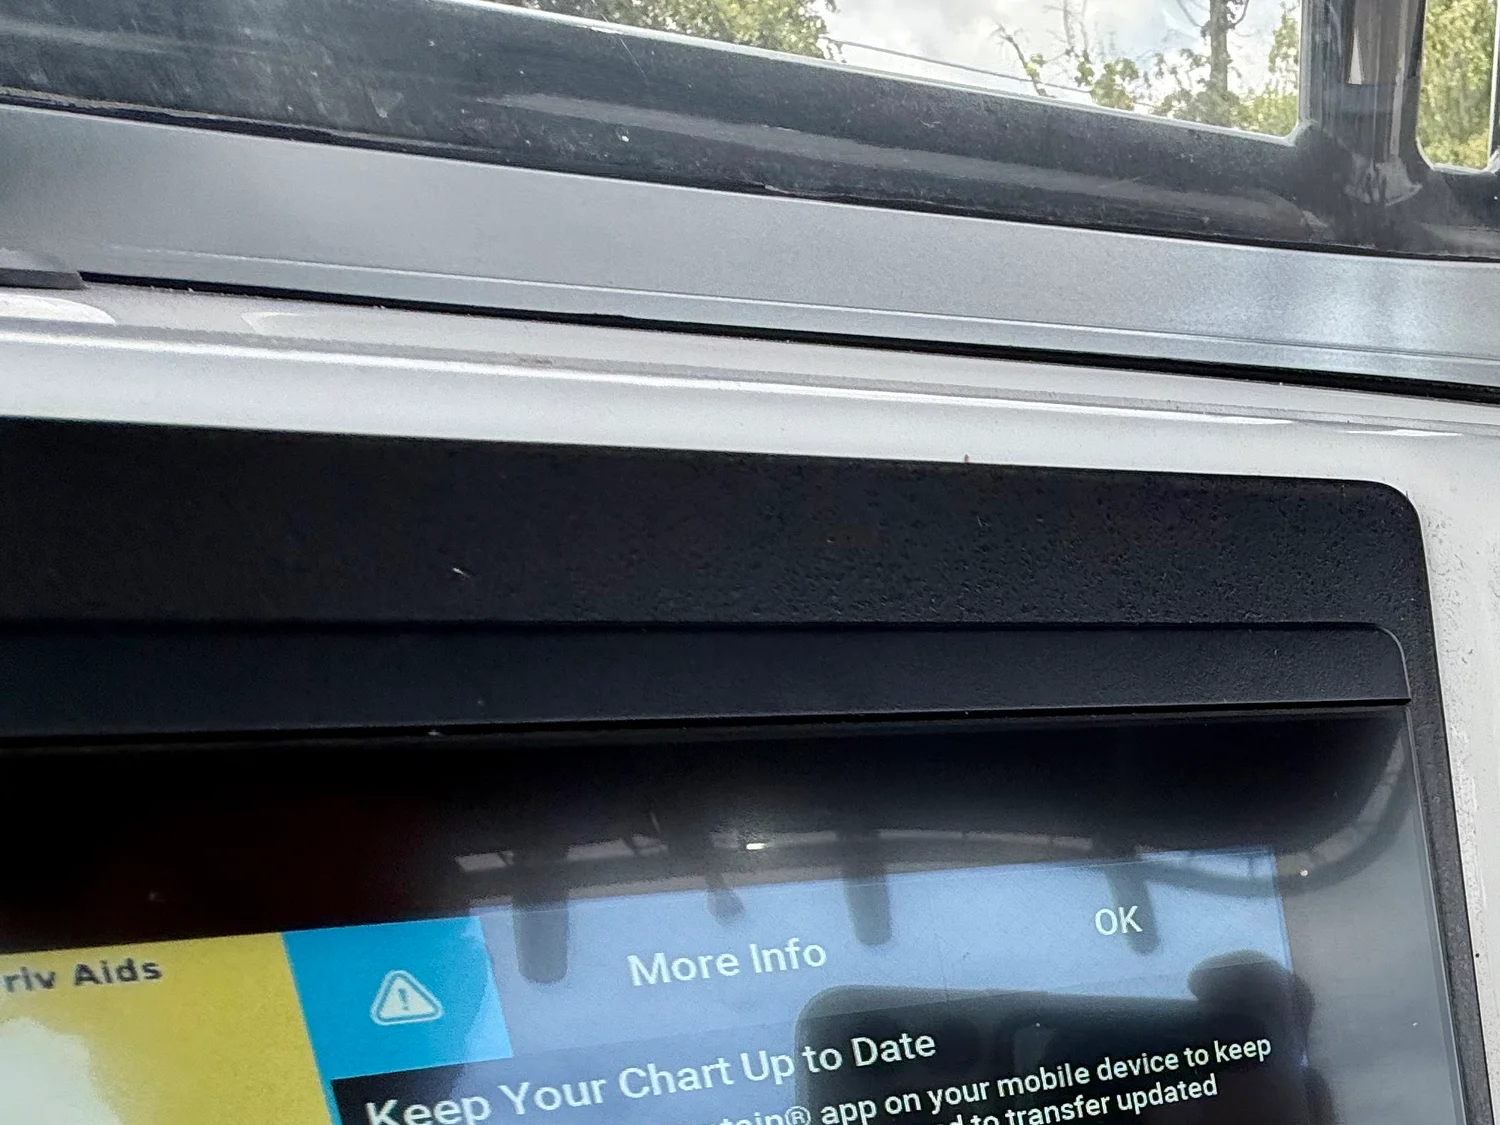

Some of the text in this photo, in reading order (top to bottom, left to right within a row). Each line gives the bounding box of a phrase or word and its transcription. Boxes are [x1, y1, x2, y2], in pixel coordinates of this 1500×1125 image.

[1095, 905, 1143, 936] OK
[2, 957, 162, 993] riv Aids
[627, 938, 827, 986] More Info
[497, 1078, 607, 1115] Your
[619, 1057, 734, 1099] Chart
[740, 1050, 795, 1085] Up
[802, 1045, 842, 1073] to
[851, 1032, 936, 1067] Date
[885, 1092, 922, 1115] on
[927, 1080, 989, 1115] your
[997, 1062, 1090, 1097] mobile
[1096, 1049, 1179, 1082] device
[1184, 1046, 1209, 1068] to
[1213, 1036, 1272, 1063] keep
[1116, 1074, 1218, 1114] updated
